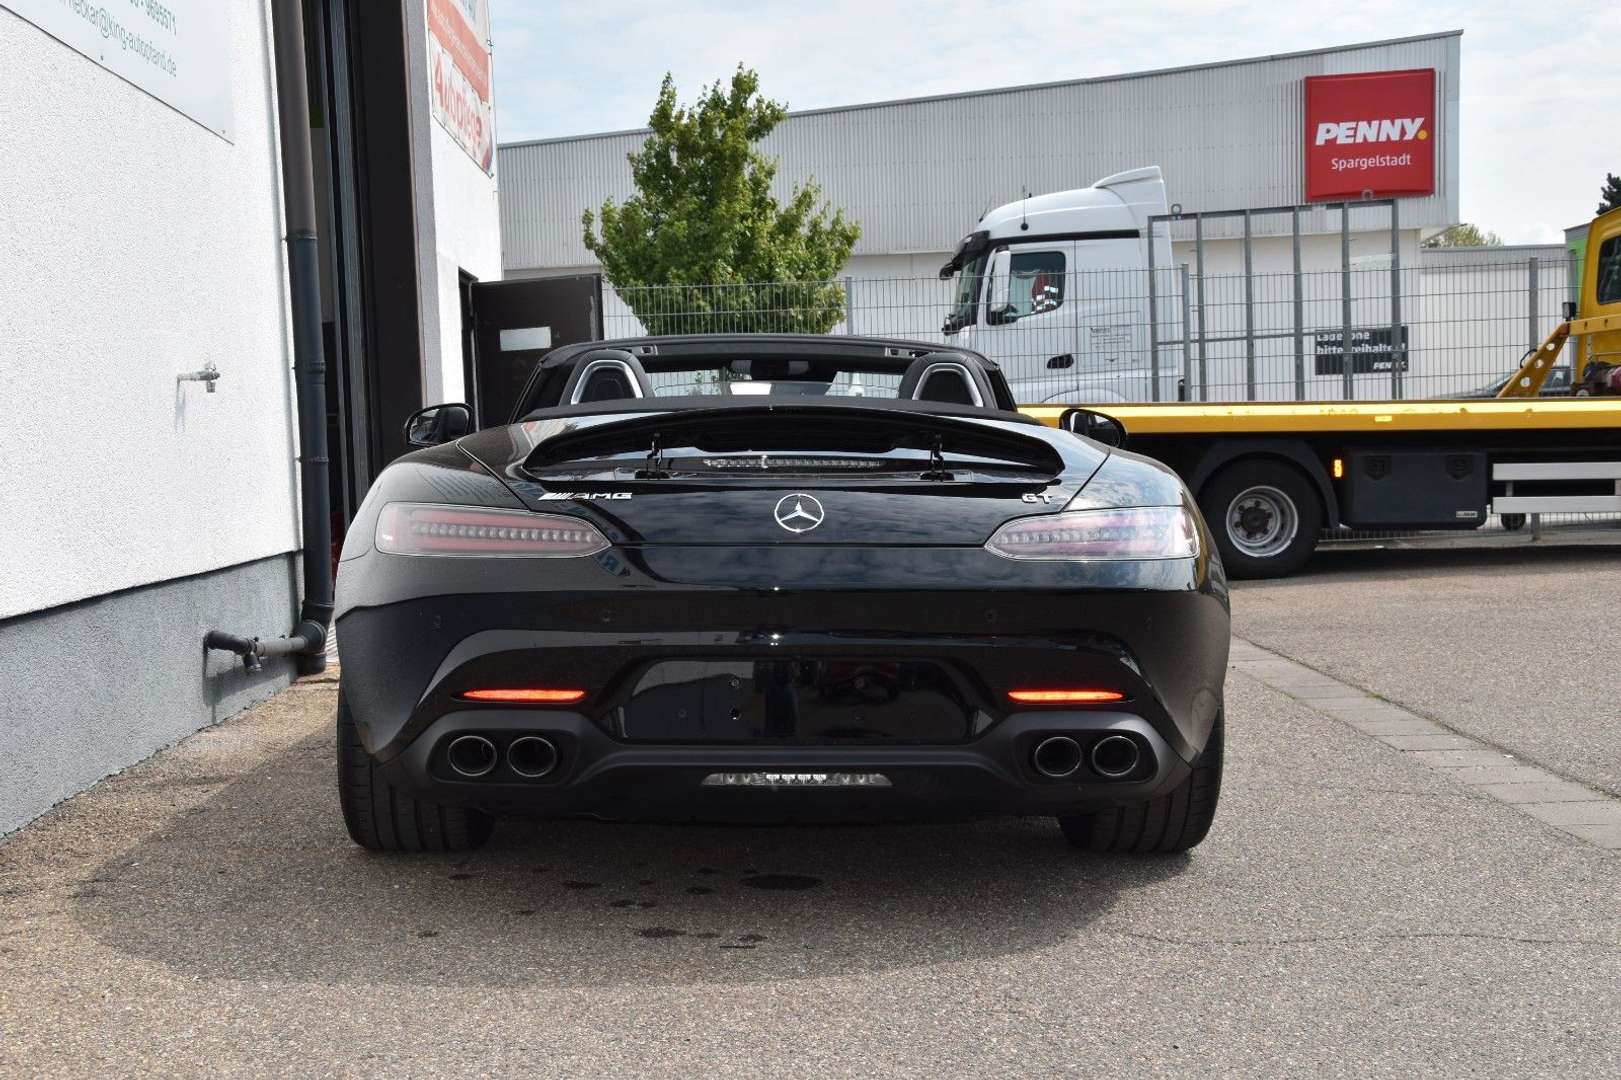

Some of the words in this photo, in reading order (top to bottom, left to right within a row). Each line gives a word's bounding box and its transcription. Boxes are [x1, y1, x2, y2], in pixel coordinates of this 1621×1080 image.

[1331, 153, 1412, 171] Spargelstadt
[1316, 344, 1344, 355] bitte
[1022, 493, 1052, 504] GT
